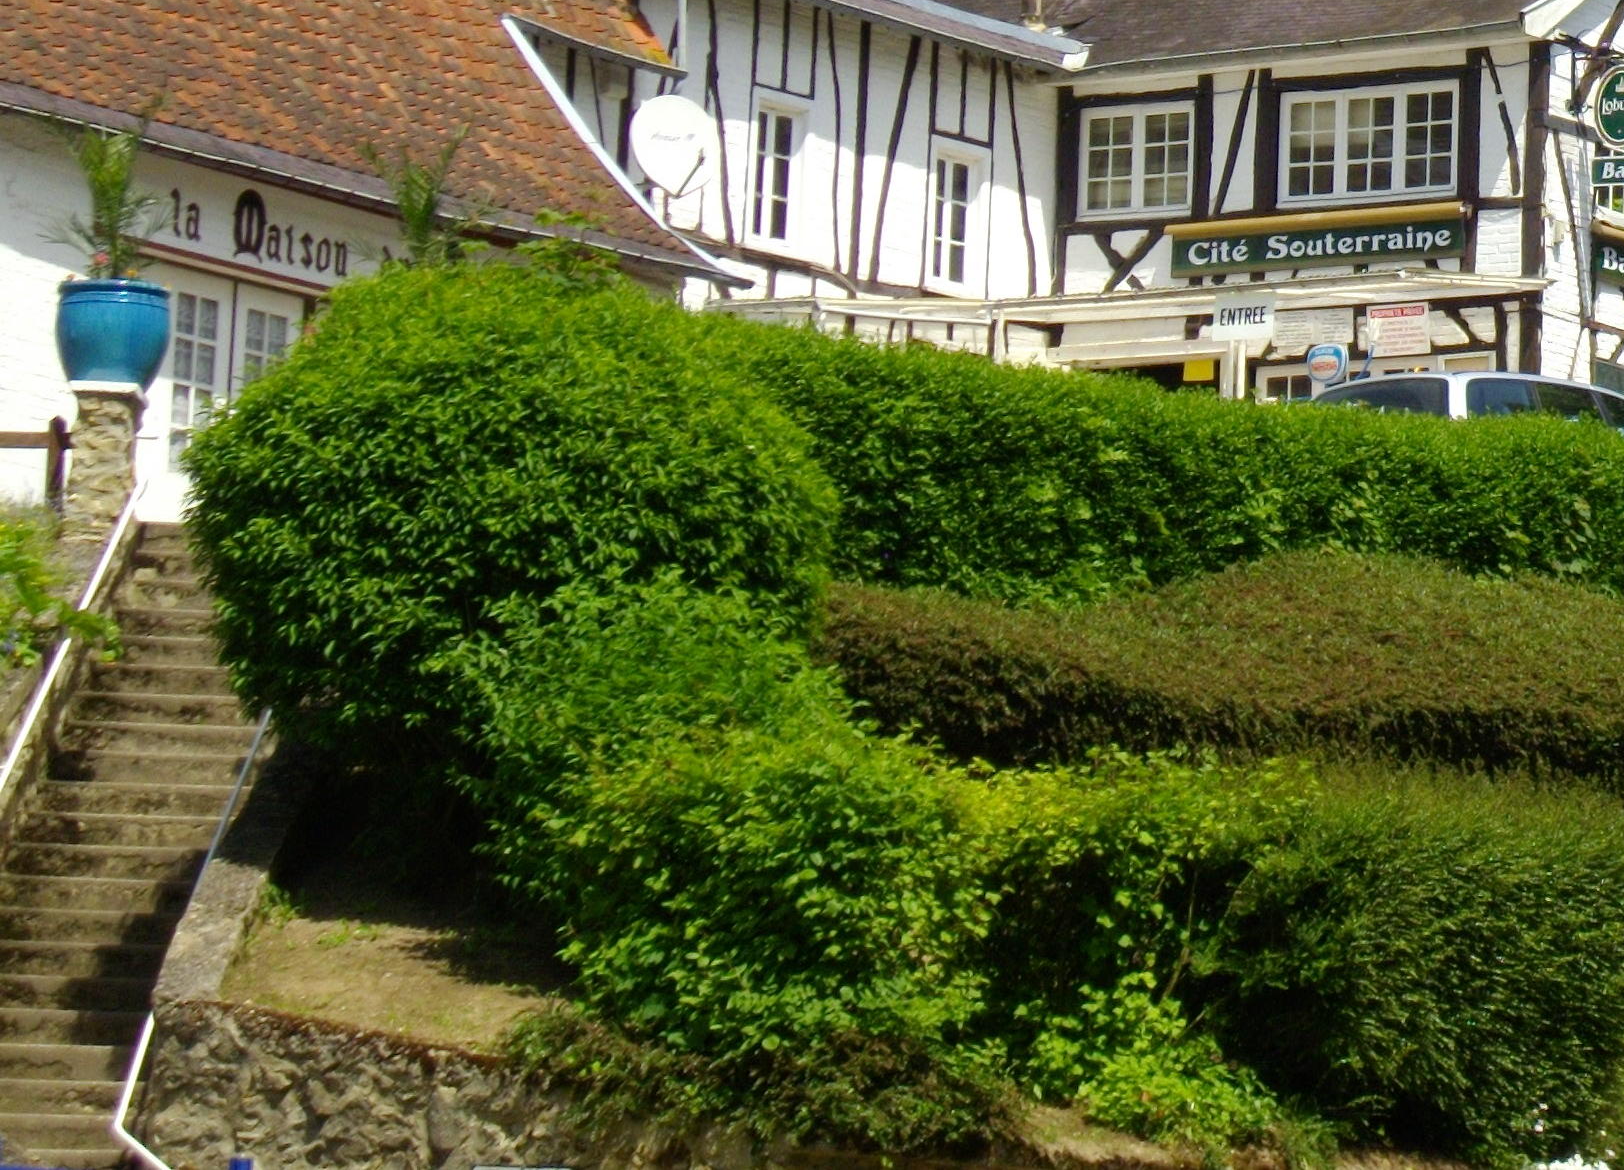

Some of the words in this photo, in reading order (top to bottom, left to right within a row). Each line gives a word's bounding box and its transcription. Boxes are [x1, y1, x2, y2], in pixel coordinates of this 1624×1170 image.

[233, 188, 349, 277] Maison
[1187, 238, 1249, 266] Cité
[1265, 226, 1452, 260] Souterraine
[1219, 305, 1267, 327] ENTREE
